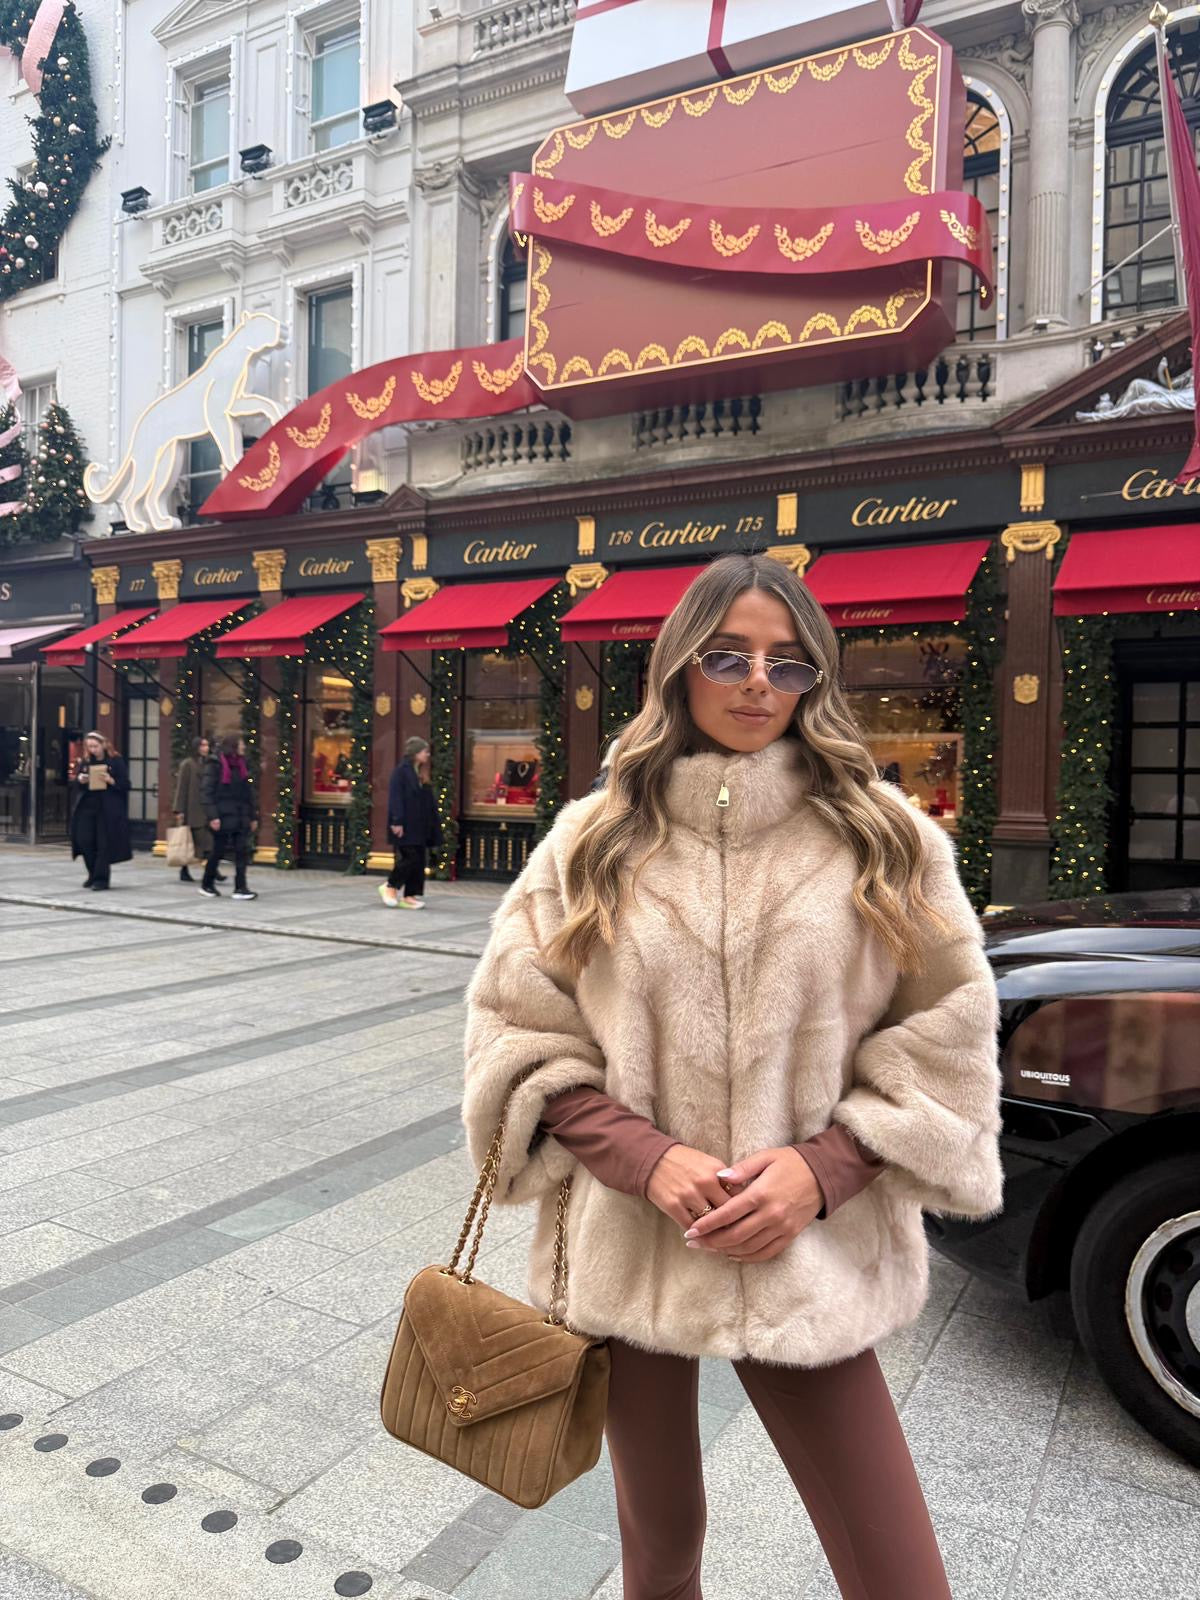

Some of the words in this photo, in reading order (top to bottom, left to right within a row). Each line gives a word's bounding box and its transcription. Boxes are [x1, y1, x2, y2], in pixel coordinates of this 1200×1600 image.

[851, 496, 958, 527] Cartier
[608, 530, 634, 546] 176
[639, 521, 727, 548] Cartier
[735, 516, 764, 533] 175
[463, 540, 538, 564] Cartier
[194, 567, 243, 586] Cartier
[299, 557, 354, 577] Cartier
[842, 608, 893, 620] Cartier
[611, 623, 652, 635] Cartier
[1020, 1069, 1070, 1081] UBIQUITOUS
